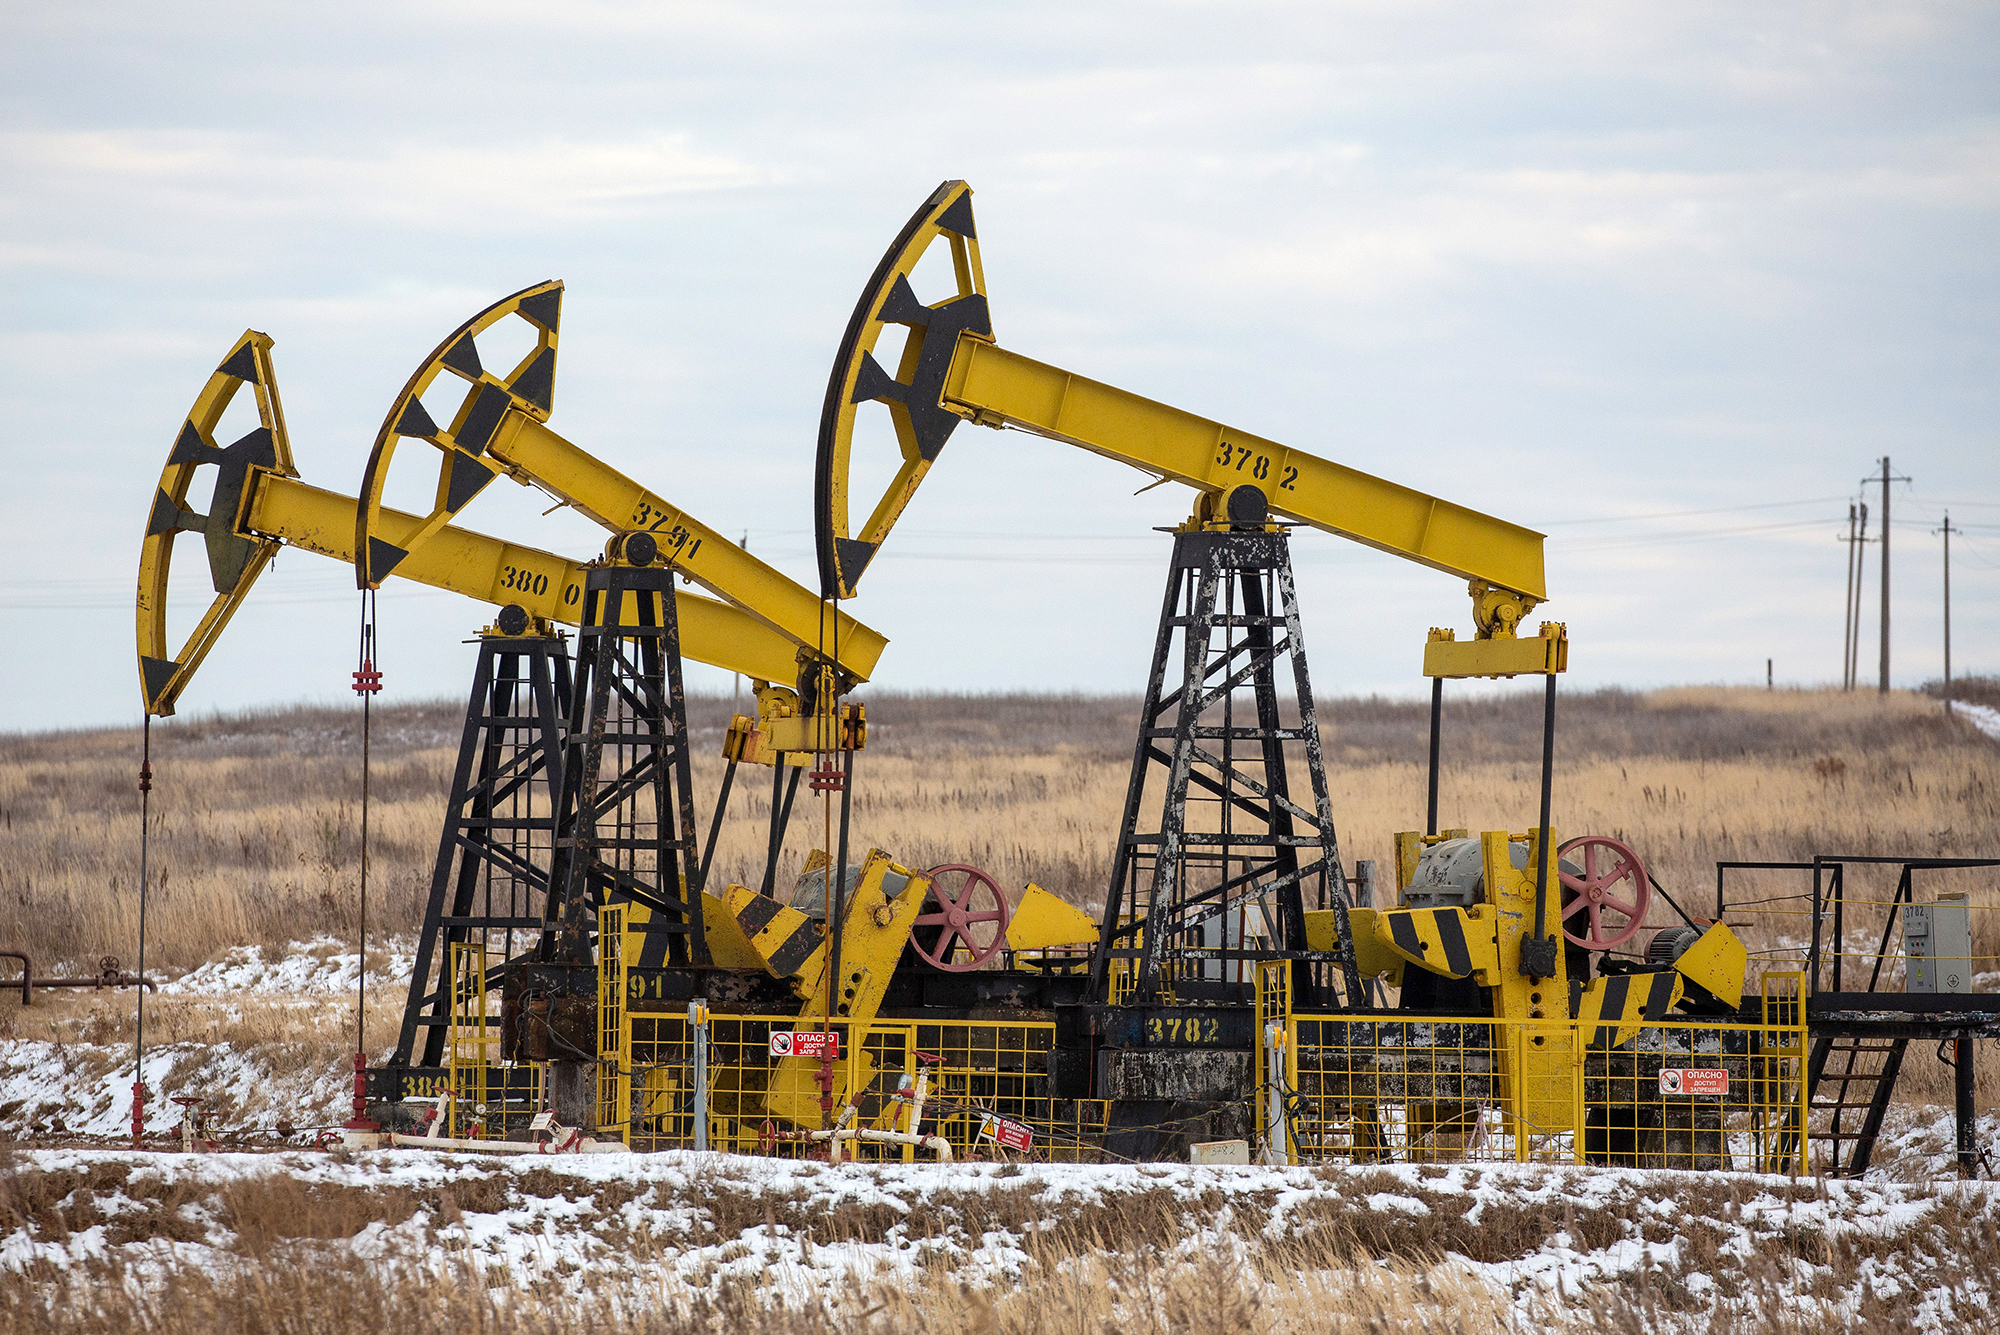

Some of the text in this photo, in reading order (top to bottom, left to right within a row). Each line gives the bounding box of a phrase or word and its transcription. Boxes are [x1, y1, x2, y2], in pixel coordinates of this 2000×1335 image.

[1904, 905, 1925, 919] 3782
[1148, 1017, 1219, 1043] 3782
[1687, 1071, 1723, 1080] ОПАСНО
[1210, 1143, 1236, 1157] 3782
